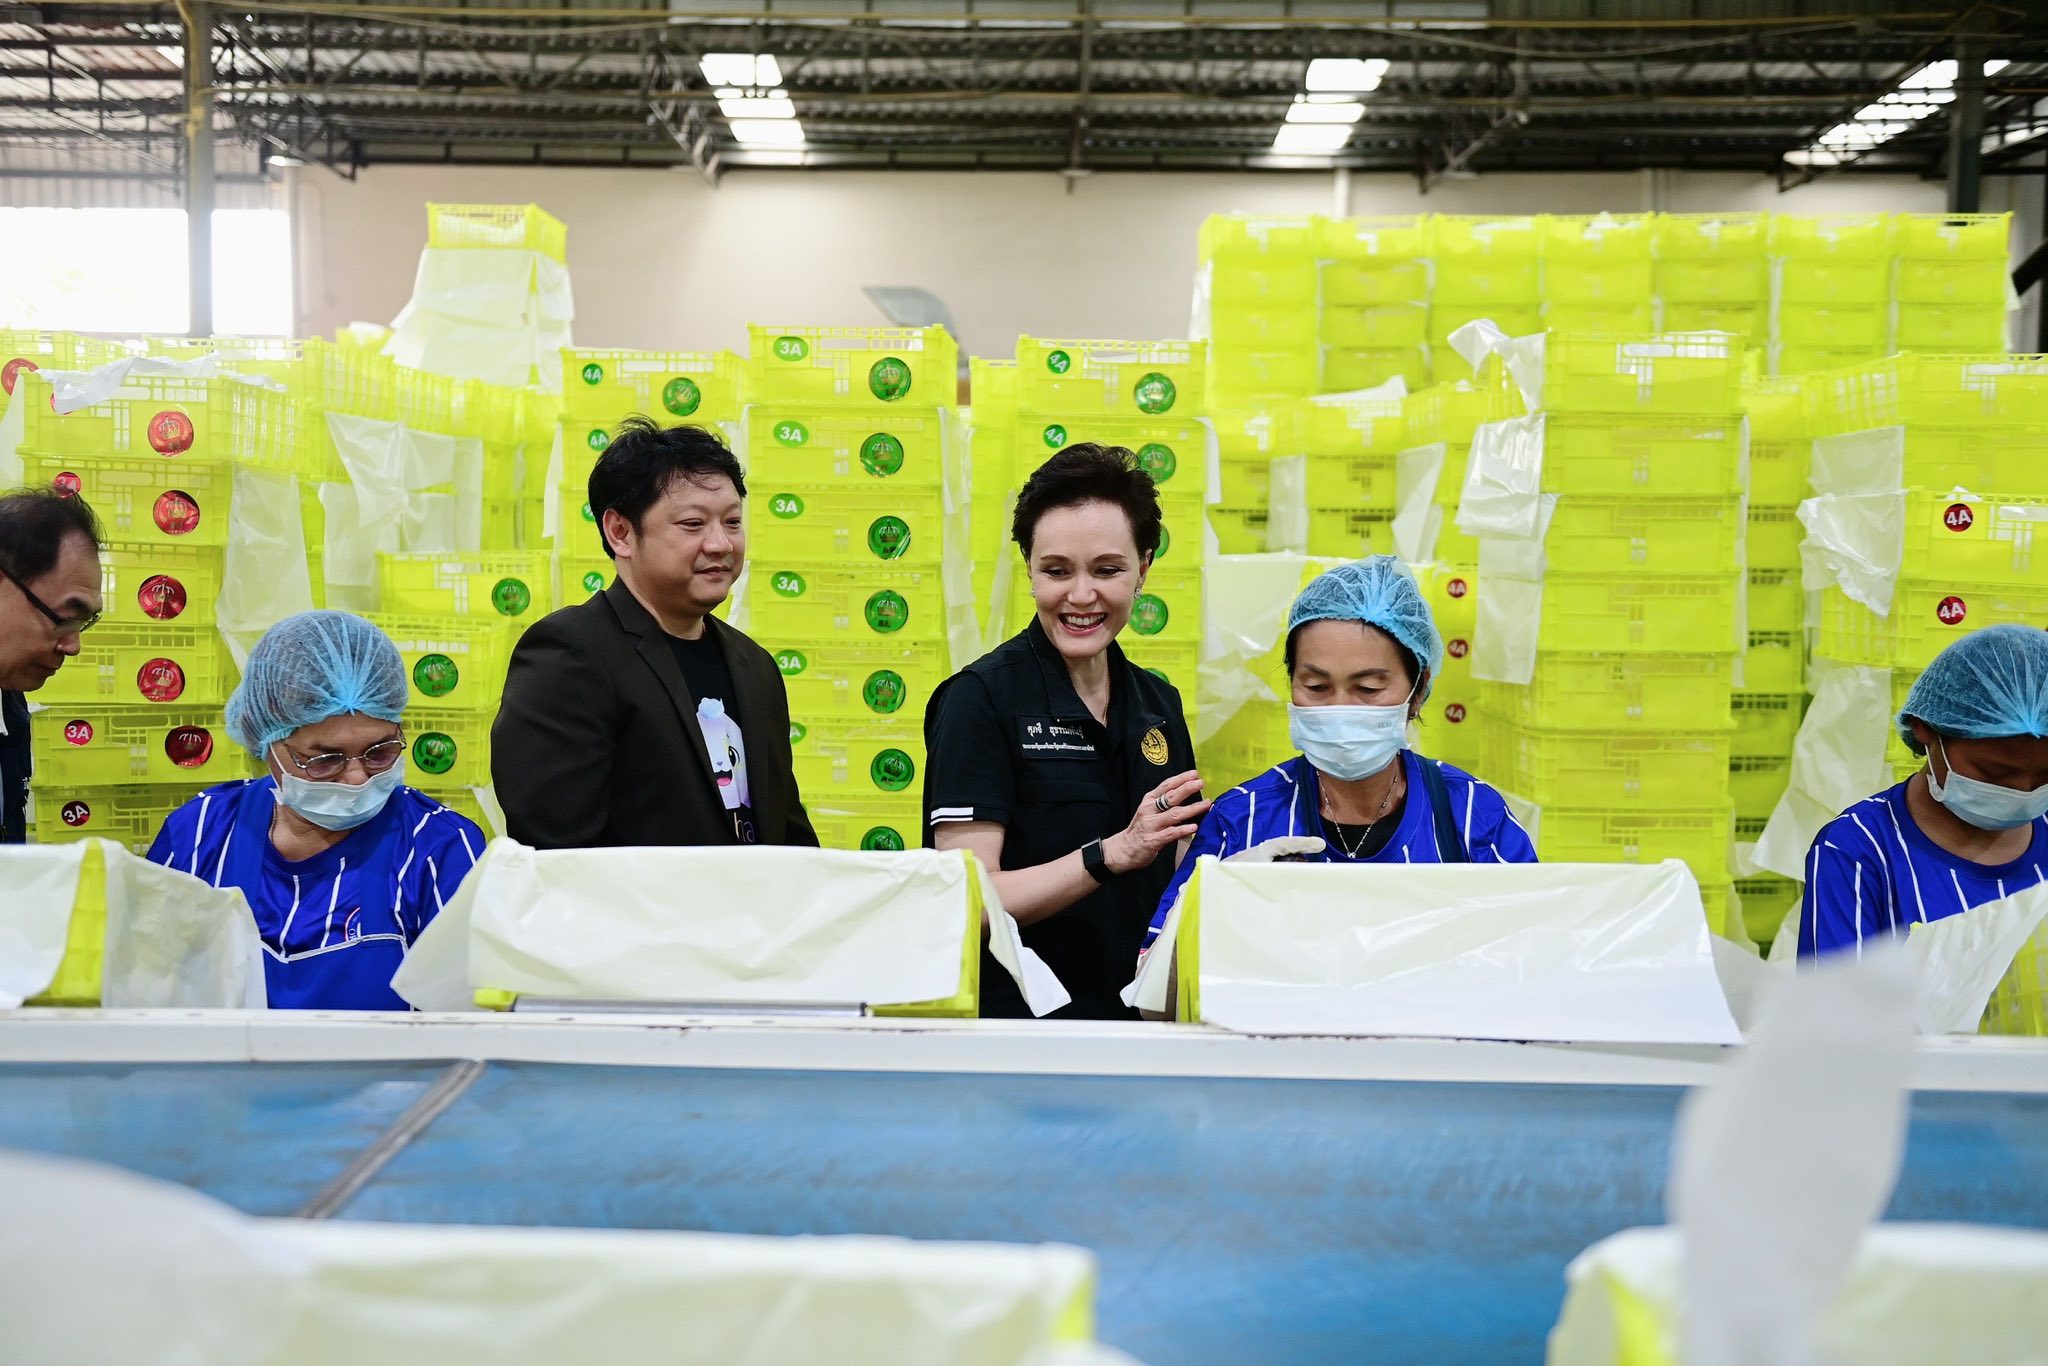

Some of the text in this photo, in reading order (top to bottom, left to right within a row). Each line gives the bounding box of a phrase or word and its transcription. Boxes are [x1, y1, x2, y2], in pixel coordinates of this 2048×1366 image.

[780, 341, 803, 357] 3A
[1050, 353, 1066, 373] 4A
[584, 367, 602, 382] 4A
[590, 433, 608, 447] 4A
[780, 426, 803, 443] 3A
[1045, 428, 1064, 446] 4A
[775, 498, 798, 513] 3A
[1946, 508, 1971, 526] 4A
[585, 574, 602, 590] 4A
[778, 576, 800, 592] 3A
[1448, 582, 1466, 595] 4A
[1939, 601, 1965, 619] 4A
[1449, 641, 1466, 656] 4A
[778, 656, 801, 669] 3A
[1446, 705, 1463, 721] 4A
[68, 725, 90, 740] 3A
[64, 805, 88, 823] 3A
